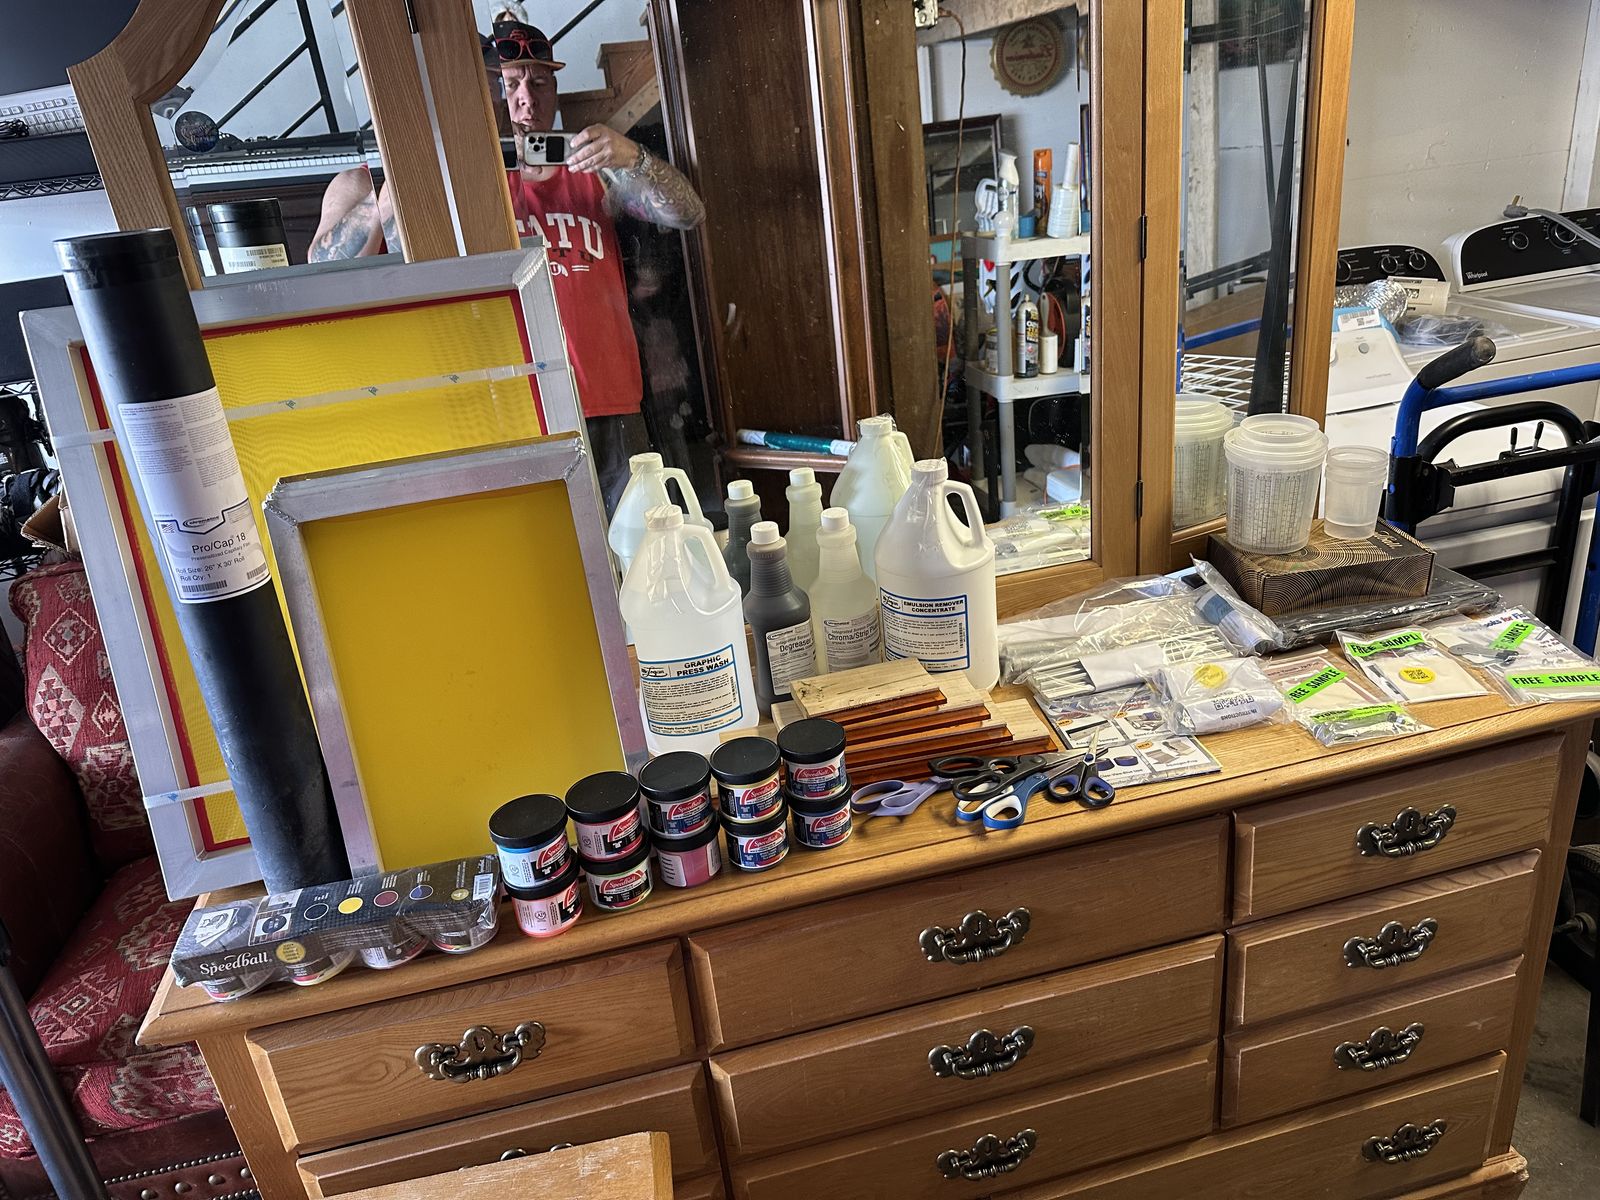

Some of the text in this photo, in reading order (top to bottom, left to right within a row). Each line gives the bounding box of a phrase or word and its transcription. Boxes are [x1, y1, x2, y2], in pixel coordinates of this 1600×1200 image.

[1466, 271, 1488, 280] Whirlpool
[236, 532, 246, 542] 18
[188, 565, 203, 574] Size:
[935, 599, 964, 607] REMOVER
[827, 630, 868, 641] Chroma/Strip
[676, 658, 730, 677] PRESS WASH
[684, 655, 721, 669] GRAPHIC
[1306, 669, 1341, 689] SAMPLE
[1512, 673, 1600, 685] FREE SAMPLE
[753, 832, 778, 847] Speedball
[609, 875, 637, 889] Speedball
[199, 952, 268, 976] Speedball
